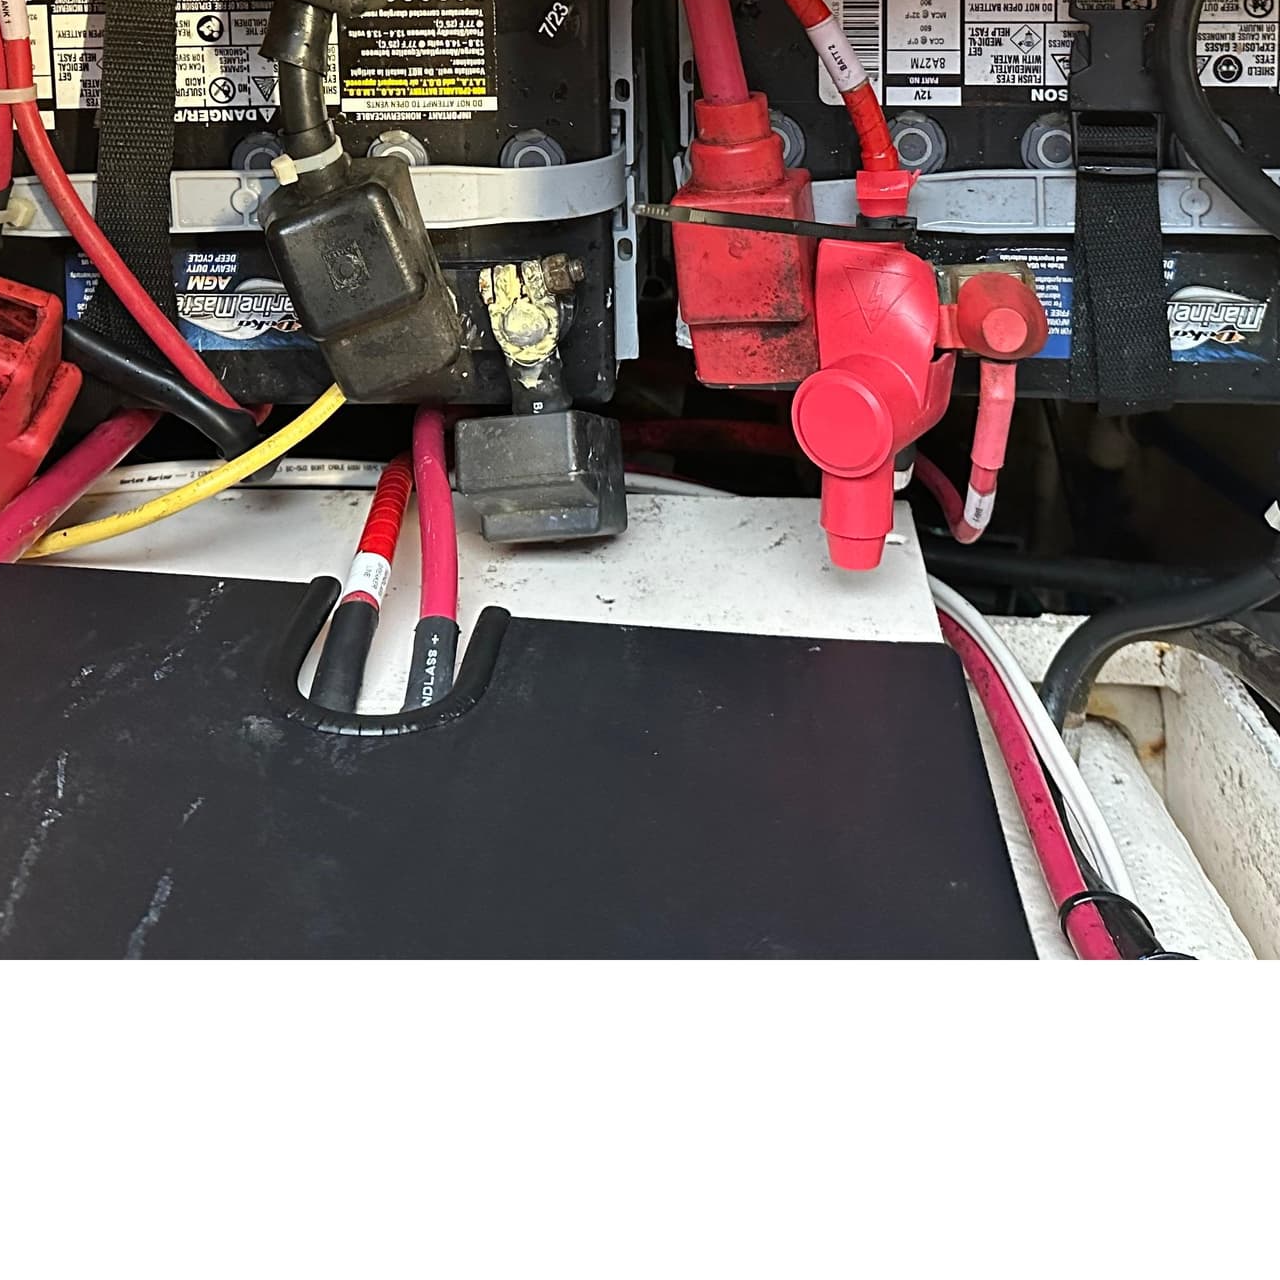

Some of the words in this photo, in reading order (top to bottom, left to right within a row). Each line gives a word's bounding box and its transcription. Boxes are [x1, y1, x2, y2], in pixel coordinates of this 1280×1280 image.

[968, 4, 1001, 12] BATTERY.
[1003, 4, 1023, 12] OPEN
[538, 1, 568, 38] 7/23
[968, 27, 988, 36] FAST.
[991, 27, 1010, 36] HELP
[968, 47, 982, 55] GET
[1205, 43, 1230, 51] GASES
[831, 48, 848, 70] BATT
[911, 58, 945, 68] 8A27M
[990, 55, 1020, 64] WATER.
[1022, 55, 1041, 64] WITH
[1252, 55, 1275, 63] EYES.
[58, 63, 89, 71] MEDICAL
[990, 65, 1041, 73] IMMEDIATELY
[1248, 67, 1275, 75] SHIELD
[58, 73, 71, 81] GET
[922, 76, 939, 84] PART
[996, 75, 1016, 83] EYES
[1018, 75, 1042, 83] FLUSH
[186, 78, 201, 86] ACID
[914, 90, 932, 100] 12V
[422, 100, 454, 108] ATTEMPT
[460, 100, 472, 108] NOT
[475, 100, 482, 108] DO
[356, 112, 421, 120] NONSERVICEABLE
[428, 112, 471, 120] IMPORTANT
[188, 254, 214, 262] CYCLE
[217, 254, 236, 262] DEEP
[187, 276, 232, 290] AGM
[1175, 303, 1265, 332] Marine
[1171, 330, 1245, 344] Deka
